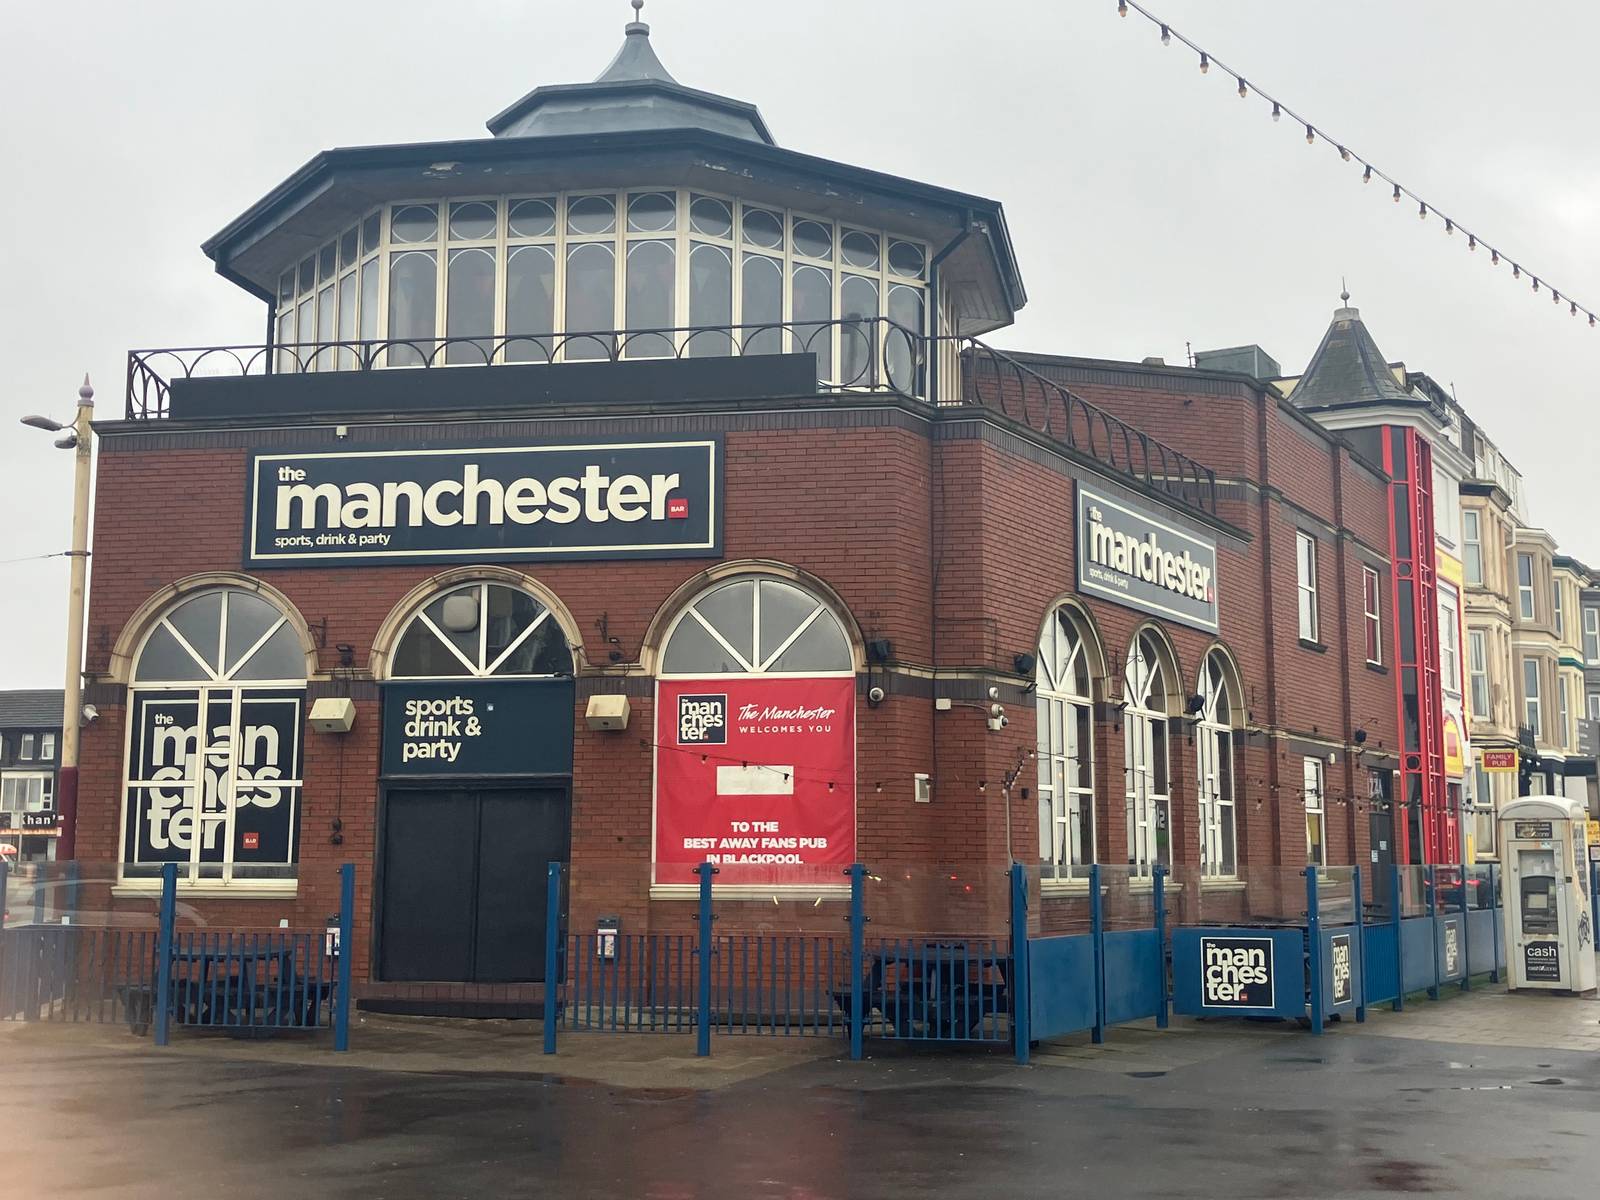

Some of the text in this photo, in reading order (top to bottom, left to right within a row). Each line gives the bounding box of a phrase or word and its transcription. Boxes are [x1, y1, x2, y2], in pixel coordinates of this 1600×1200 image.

[278, 466, 306, 481] the
[276, 464, 680, 530] manchester
[275, 533, 391, 548] sports, drink & party
[1089, 520, 1210, 602] manchester
[405, 696, 474, 720] sports
[681, 701, 722, 715] man
[738, 704, 835, 721] The Manchester
[154, 714, 174, 724] the
[404, 716, 481, 736] drink &
[681, 711, 723, 728] ches
[681, 725, 707, 740] ter
[739, 725, 831, 734] WELCOMES YOU
[152, 725, 279, 766] man
[403, 739, 462, 762] party
[1486, 753, 1512, 761] FAMILY
[149, 753, 282, 808] ches
[731, 821, 779, 832] TO THE
[683, 838, 828, 849] BEST AWAY FANS PUB
[706, 854, 804, 865] IN BLACKPOOL
[1206, 947, 1265, 967] man
[1527, 946, 1557, 957] cash
[1206, 960, 1268, 984] ches
[1206, 980, 1245, 1001] ter
